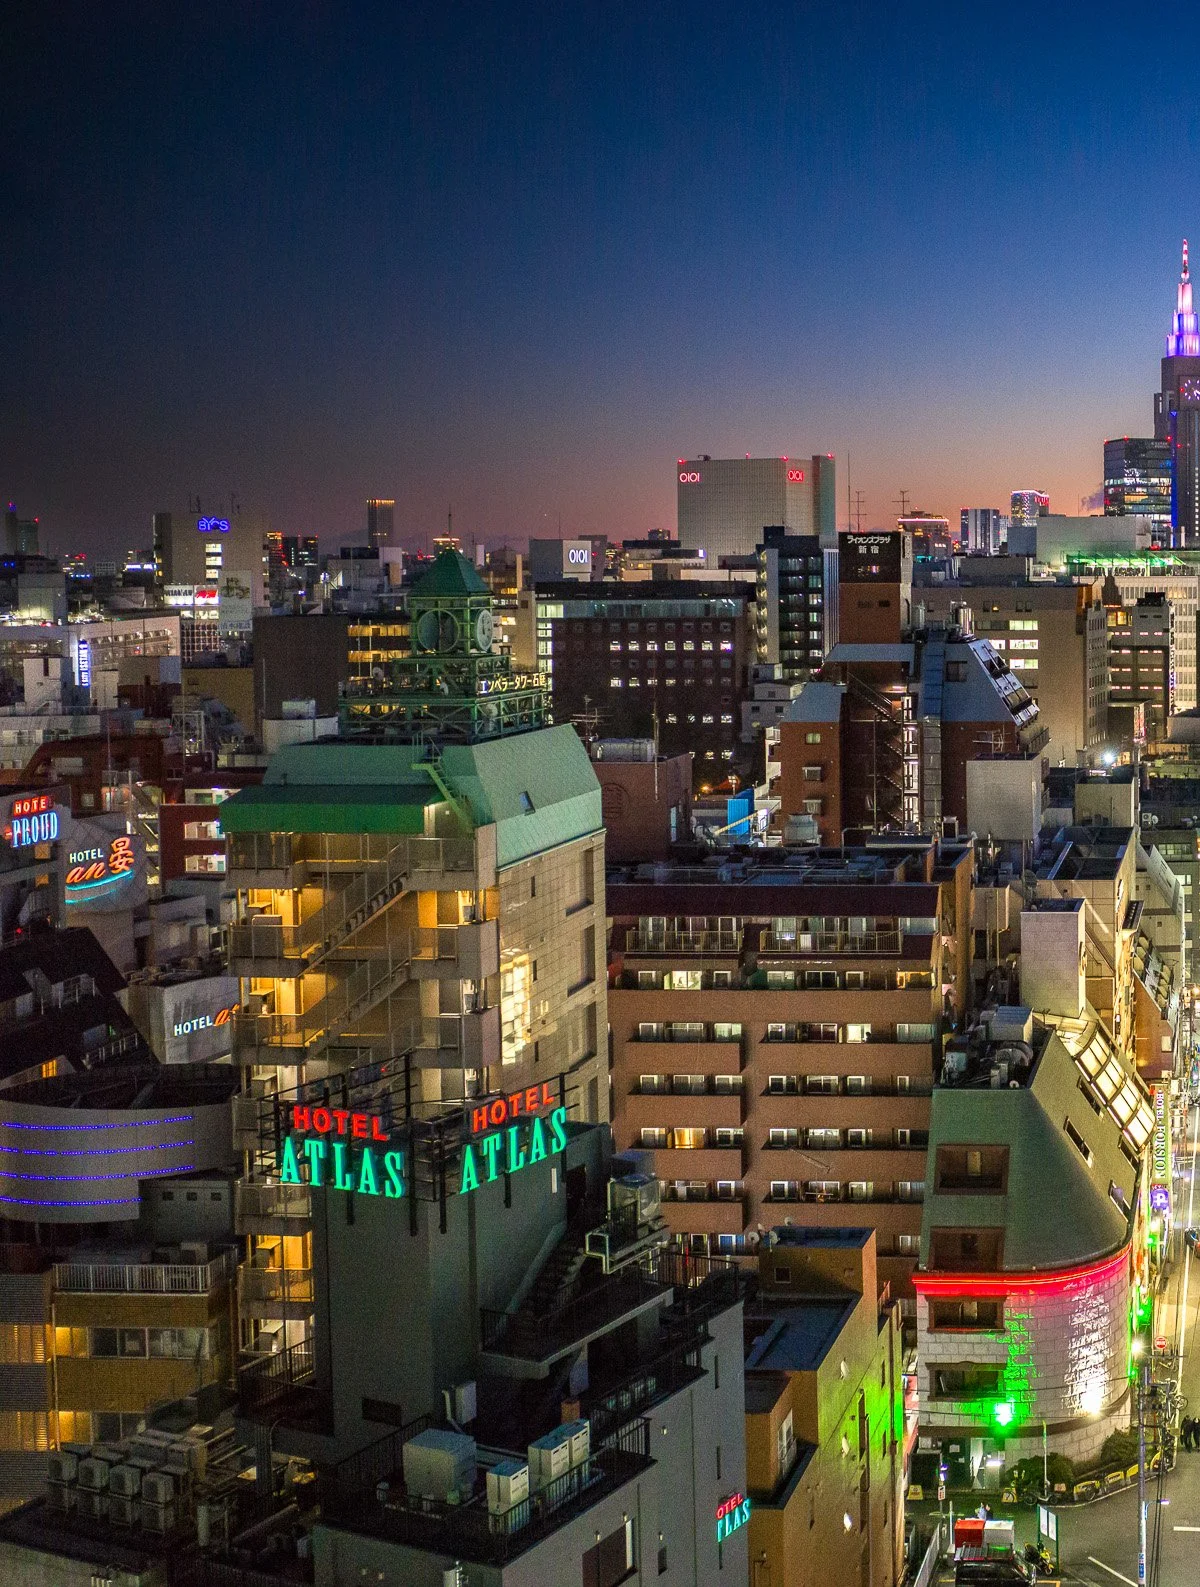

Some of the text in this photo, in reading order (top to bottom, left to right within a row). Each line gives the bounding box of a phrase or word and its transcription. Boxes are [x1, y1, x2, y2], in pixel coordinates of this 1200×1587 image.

[12, 812, 58, 848] PROUD
[66, 862, 106, 884] an
[70, 848, 104, 863] HOTEL
[174, 1015, 213, 1037] HOTEL
[293, 1105, 390, 1141] HOTEL
[472, 1083, 554, 1133] HOTEL
[1156, 1093, 1165, 1120] HOTEL
[280, 1136, 404, 1198] ATLAS
[459, 1106, 566, 1194] ATLAS
